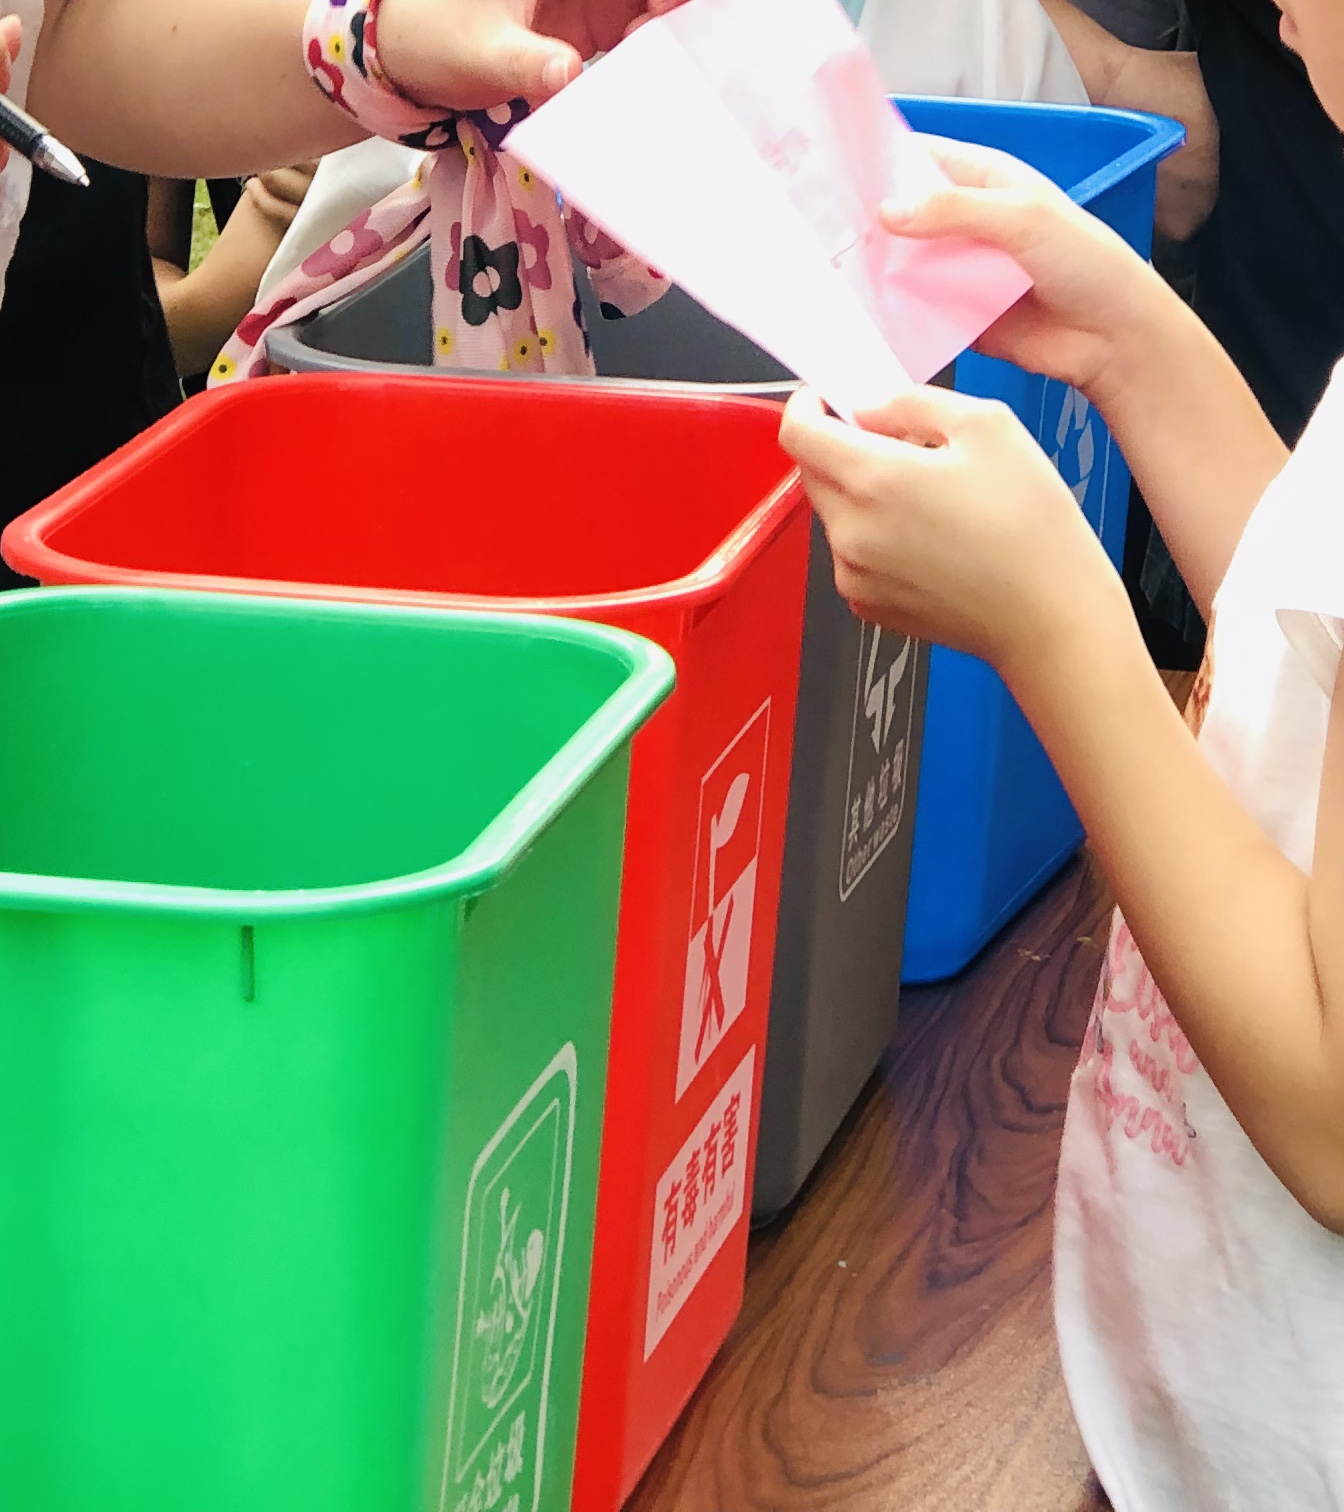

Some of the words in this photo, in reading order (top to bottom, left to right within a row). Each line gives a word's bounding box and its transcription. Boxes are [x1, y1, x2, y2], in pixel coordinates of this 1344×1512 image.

[847, 737, 905, 853] 其他垃圾
[661, 1090, 741, 1266] 有毒有害
